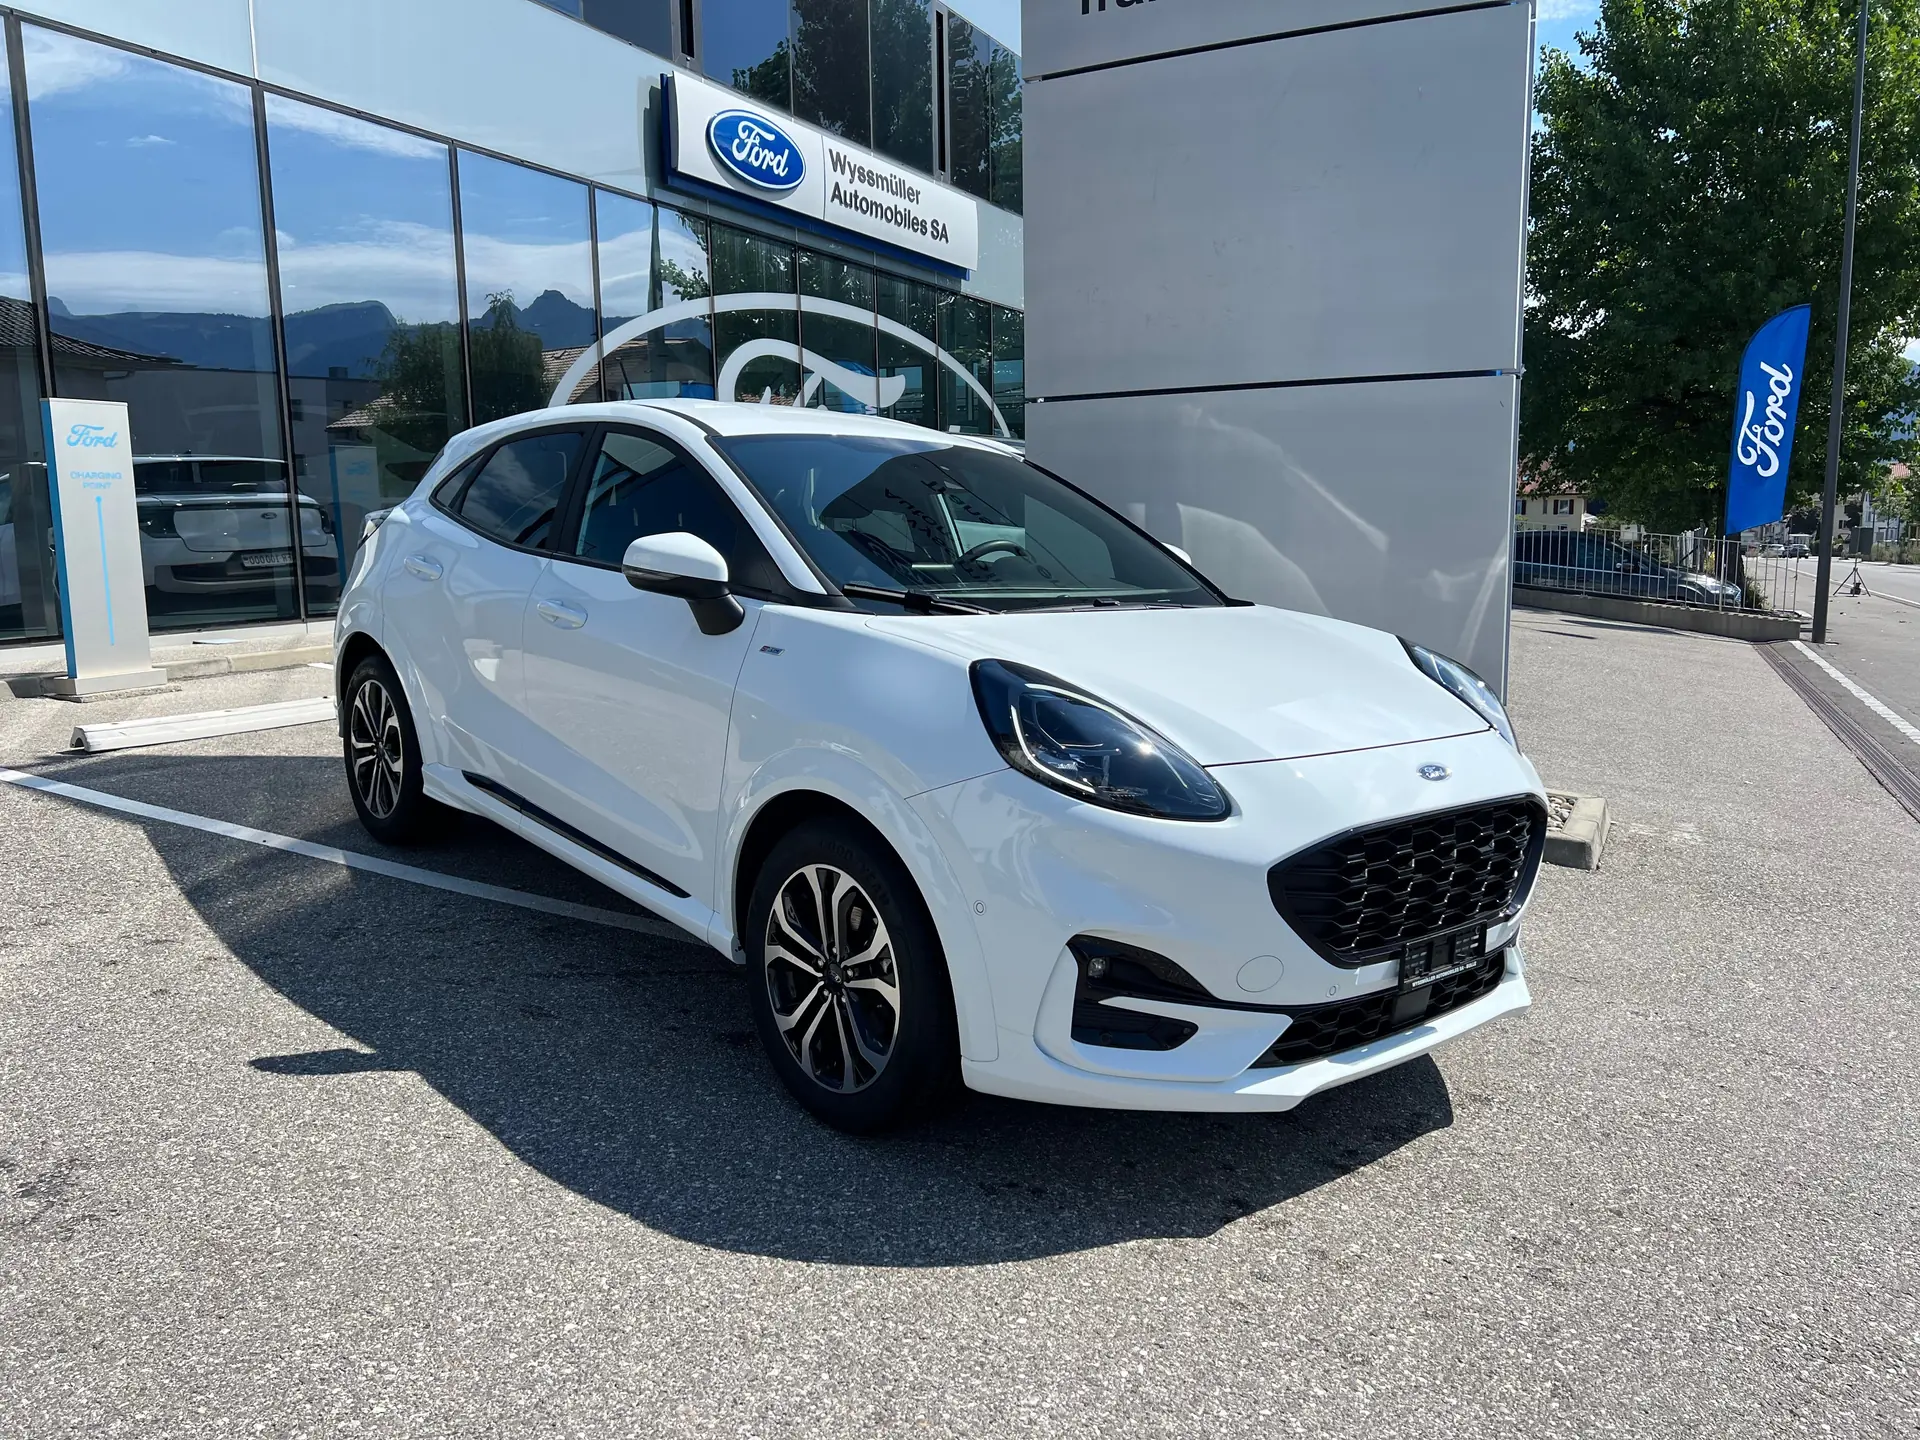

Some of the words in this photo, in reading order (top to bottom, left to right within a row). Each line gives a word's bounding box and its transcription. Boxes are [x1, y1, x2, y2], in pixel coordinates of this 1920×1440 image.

[731, 120, 790, 178] Ford
[828, 148, 921, 206] Wyssmüller
[830, 182, 928, 236] Automobiles
[930, 219, 949, 244] SA
[66, 424, 119, 448] Ford
[1737, 361, 1794, 478] Ford
[70, 471, 122, 480] CHARGING
[83, 481, 112, 489] POINT
